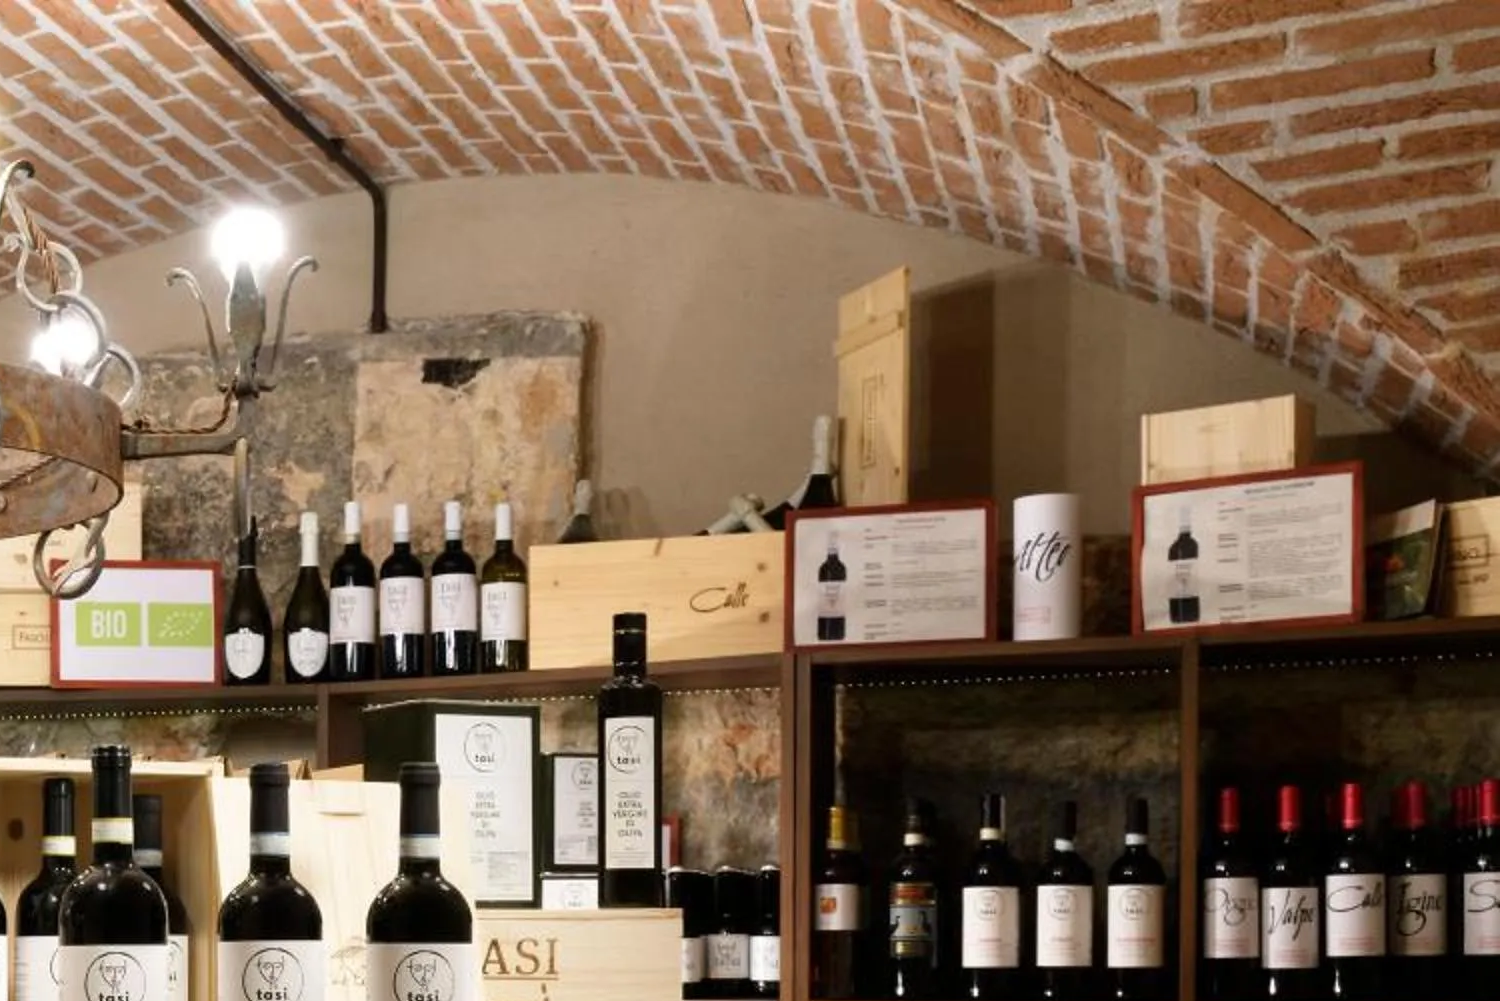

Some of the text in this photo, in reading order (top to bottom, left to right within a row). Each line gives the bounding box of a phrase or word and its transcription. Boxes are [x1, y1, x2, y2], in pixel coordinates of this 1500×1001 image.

[91, 610, 127, 638] BIO
[482, 938, 559, 975] ASI
[256, 988, 288, 1001] tasi
